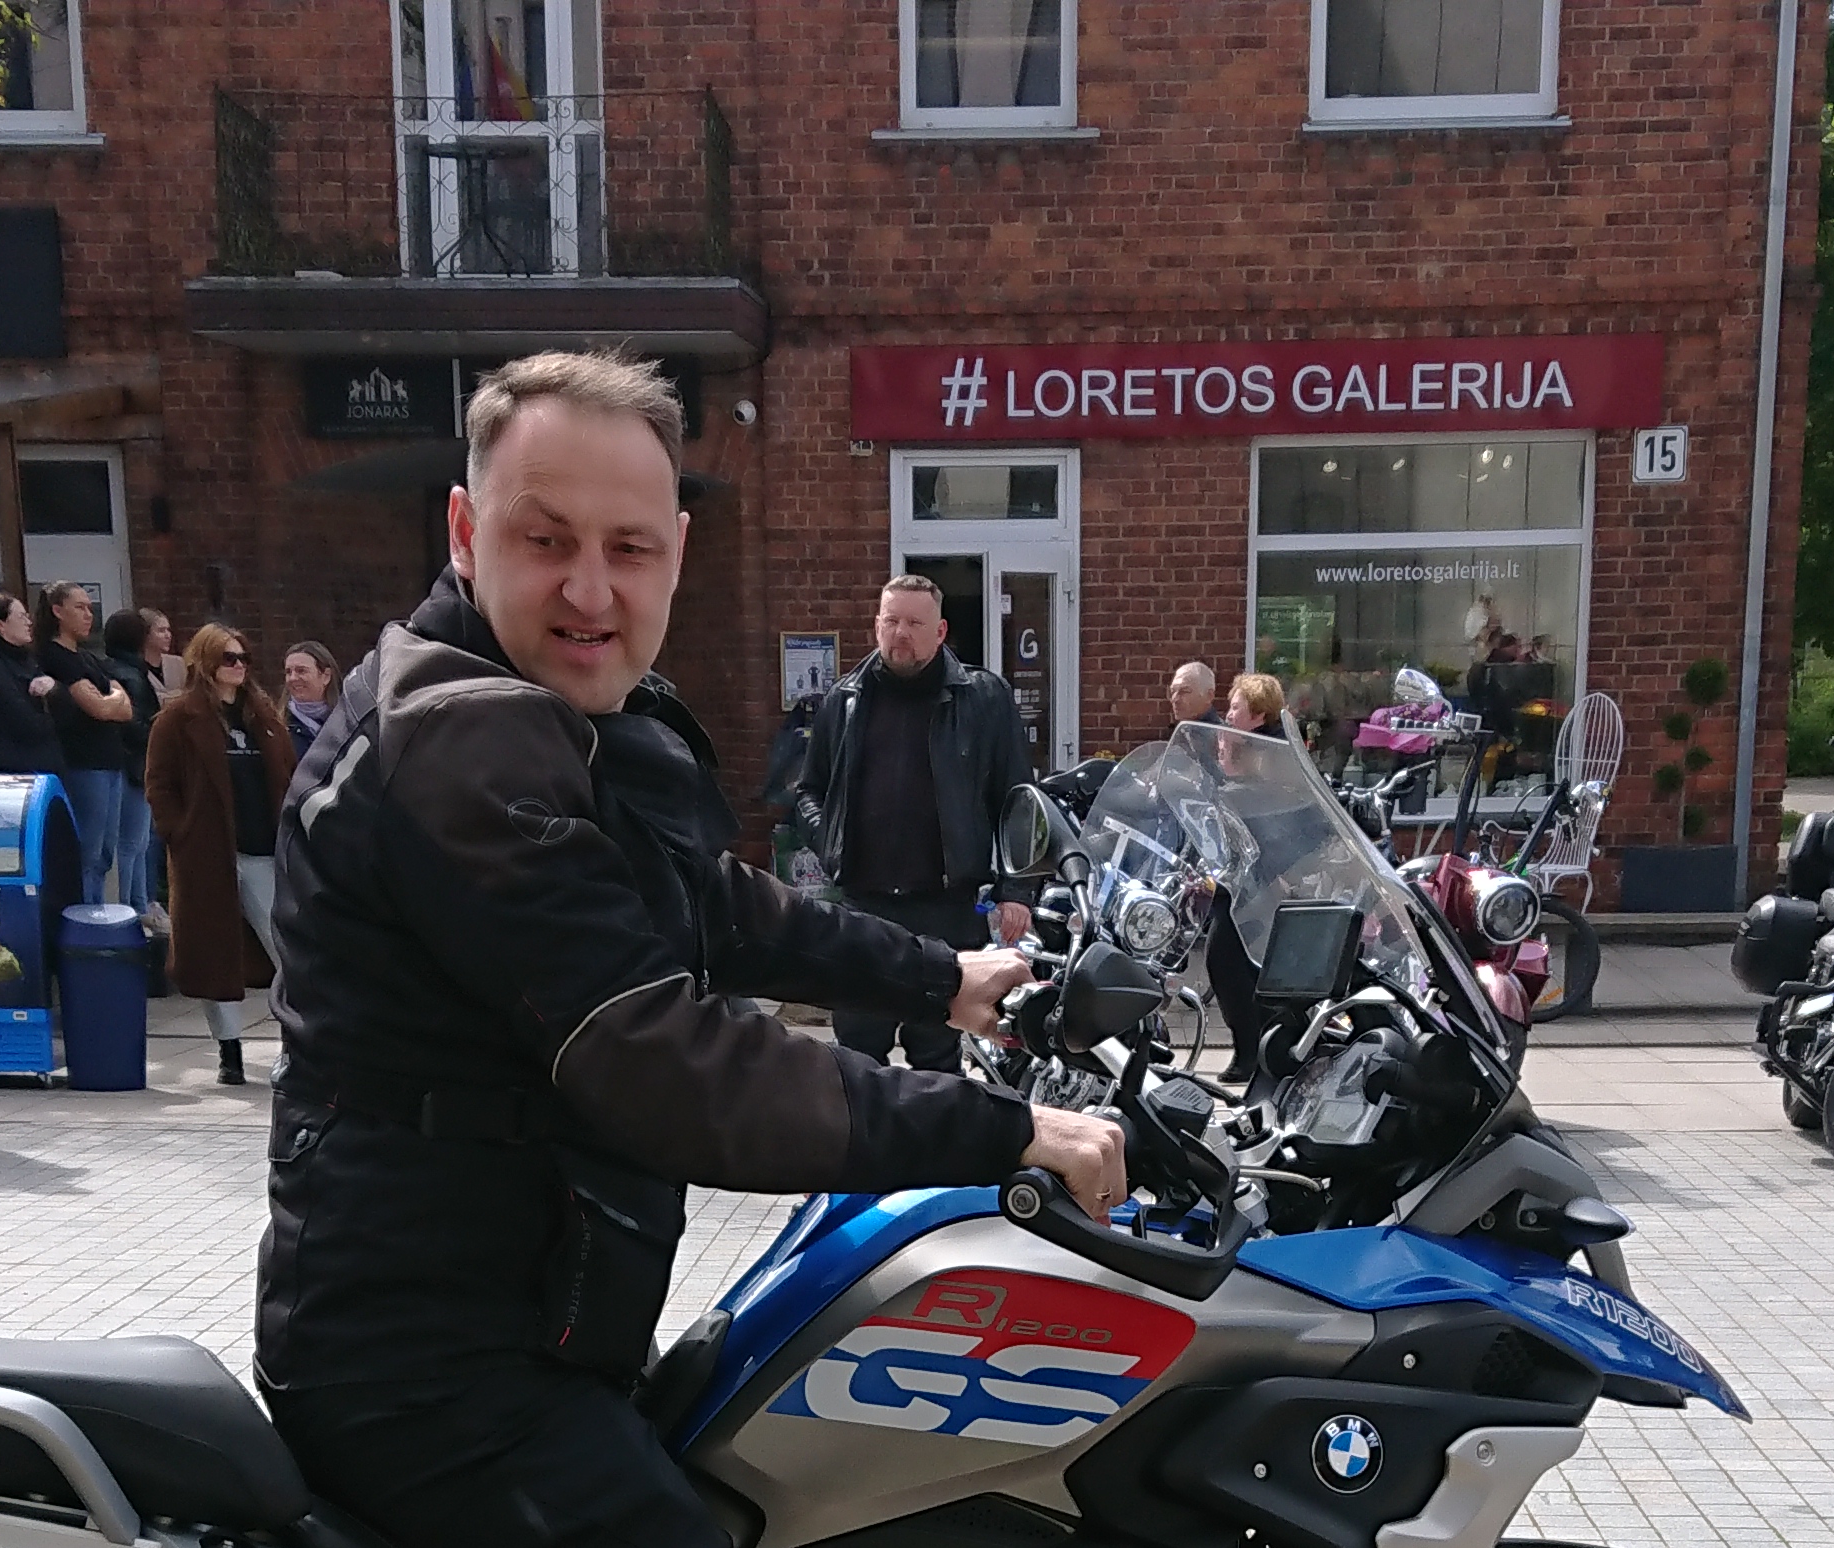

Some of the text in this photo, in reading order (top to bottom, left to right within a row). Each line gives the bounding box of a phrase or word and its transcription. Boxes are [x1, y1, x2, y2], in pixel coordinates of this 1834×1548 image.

[345, 405, 410, 420] JONARAS
[941, 356, 1574, 427] # LORETOS GALERIJA
[1643, 434, 1678, 474] 15
[1315, 559, 1520, 584] www.loretosgalerija.lt
[1565, 1277, 1706, 1374] R1200
[804, 1324, 1142, 1449] GS
